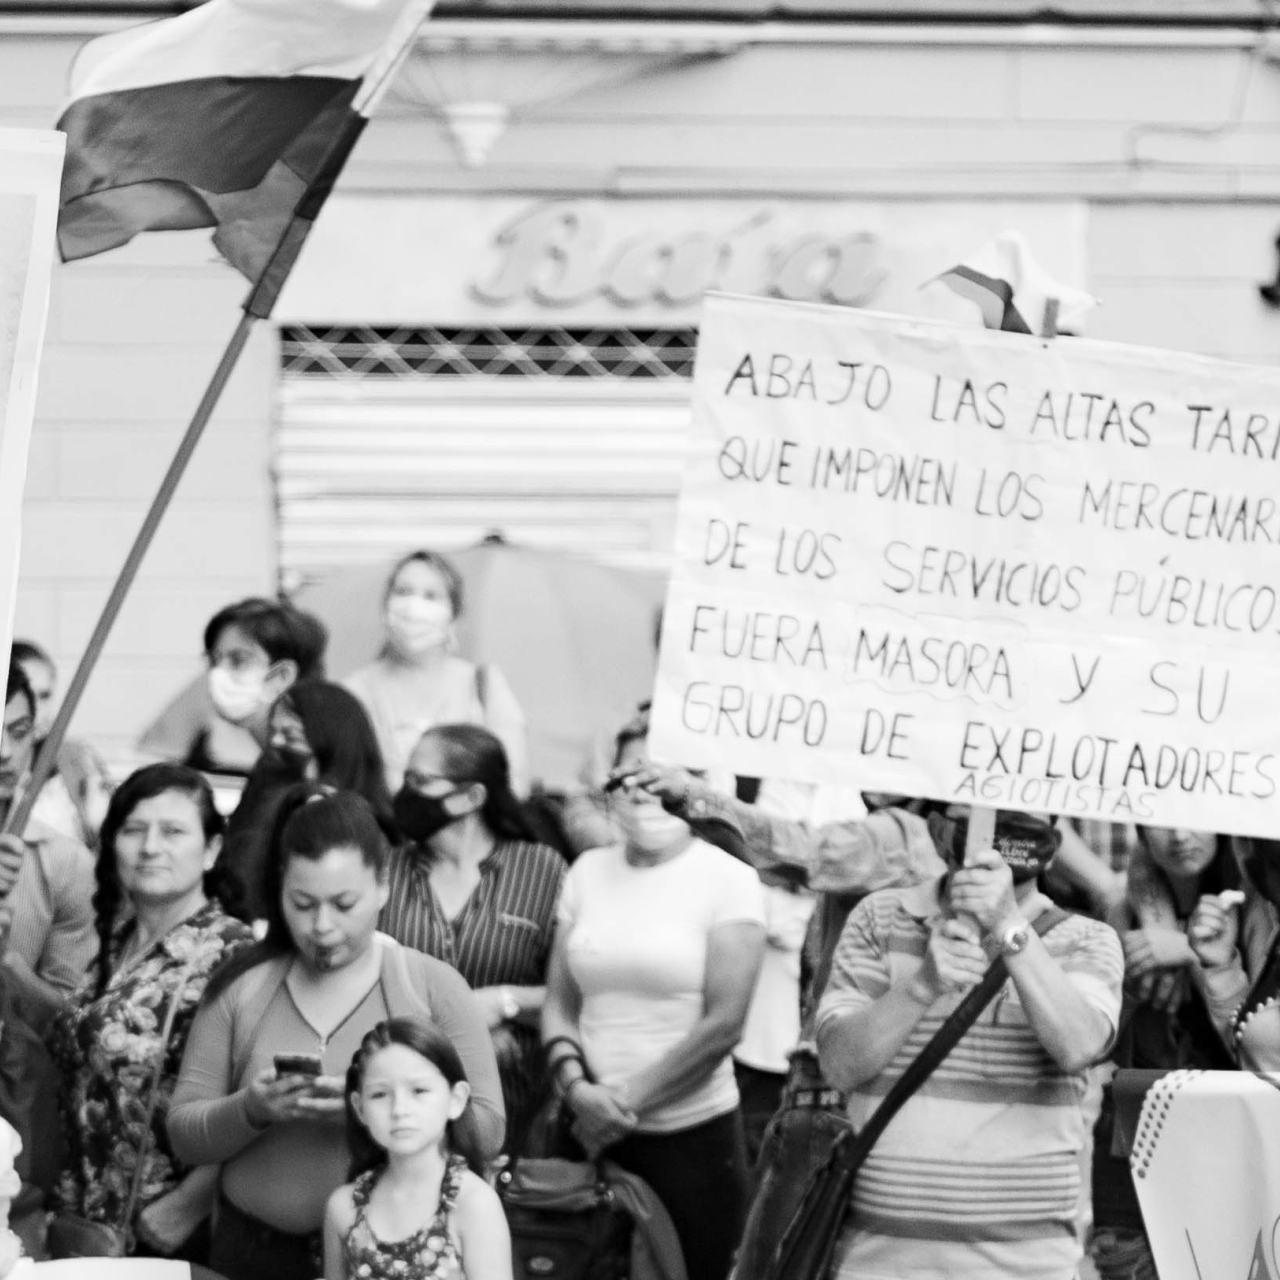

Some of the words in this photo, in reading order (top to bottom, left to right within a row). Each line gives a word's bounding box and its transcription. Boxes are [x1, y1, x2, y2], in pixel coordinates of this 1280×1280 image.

[724, 354, 891, 410] ABAJO
[931, 375, 1008, 429] LAS
[1029, 391, 1156, 448] ALTAS
[720, 436, 799, 486] QUE
[811, 444, 958, 507] IMPONEN
[974, 468, 1045, 521] LOS
[704, 519, 748, 569] DE
[776, 528, 842, 580] LOS
[882, 541, 1086, 612] SERVICIOS
[690, 605, 826, 669] FUERA
[854, 629, 1014, 698] MASORA
[1141, 661, 1229, 725] SU
[681, 681, 826, 748] GRUPO
[861, 708, 914, 760] DE
[959, 721, 1275, 799] EXPLOTADORES
[954, 772, 1157, 818] AGIOTISTAS
